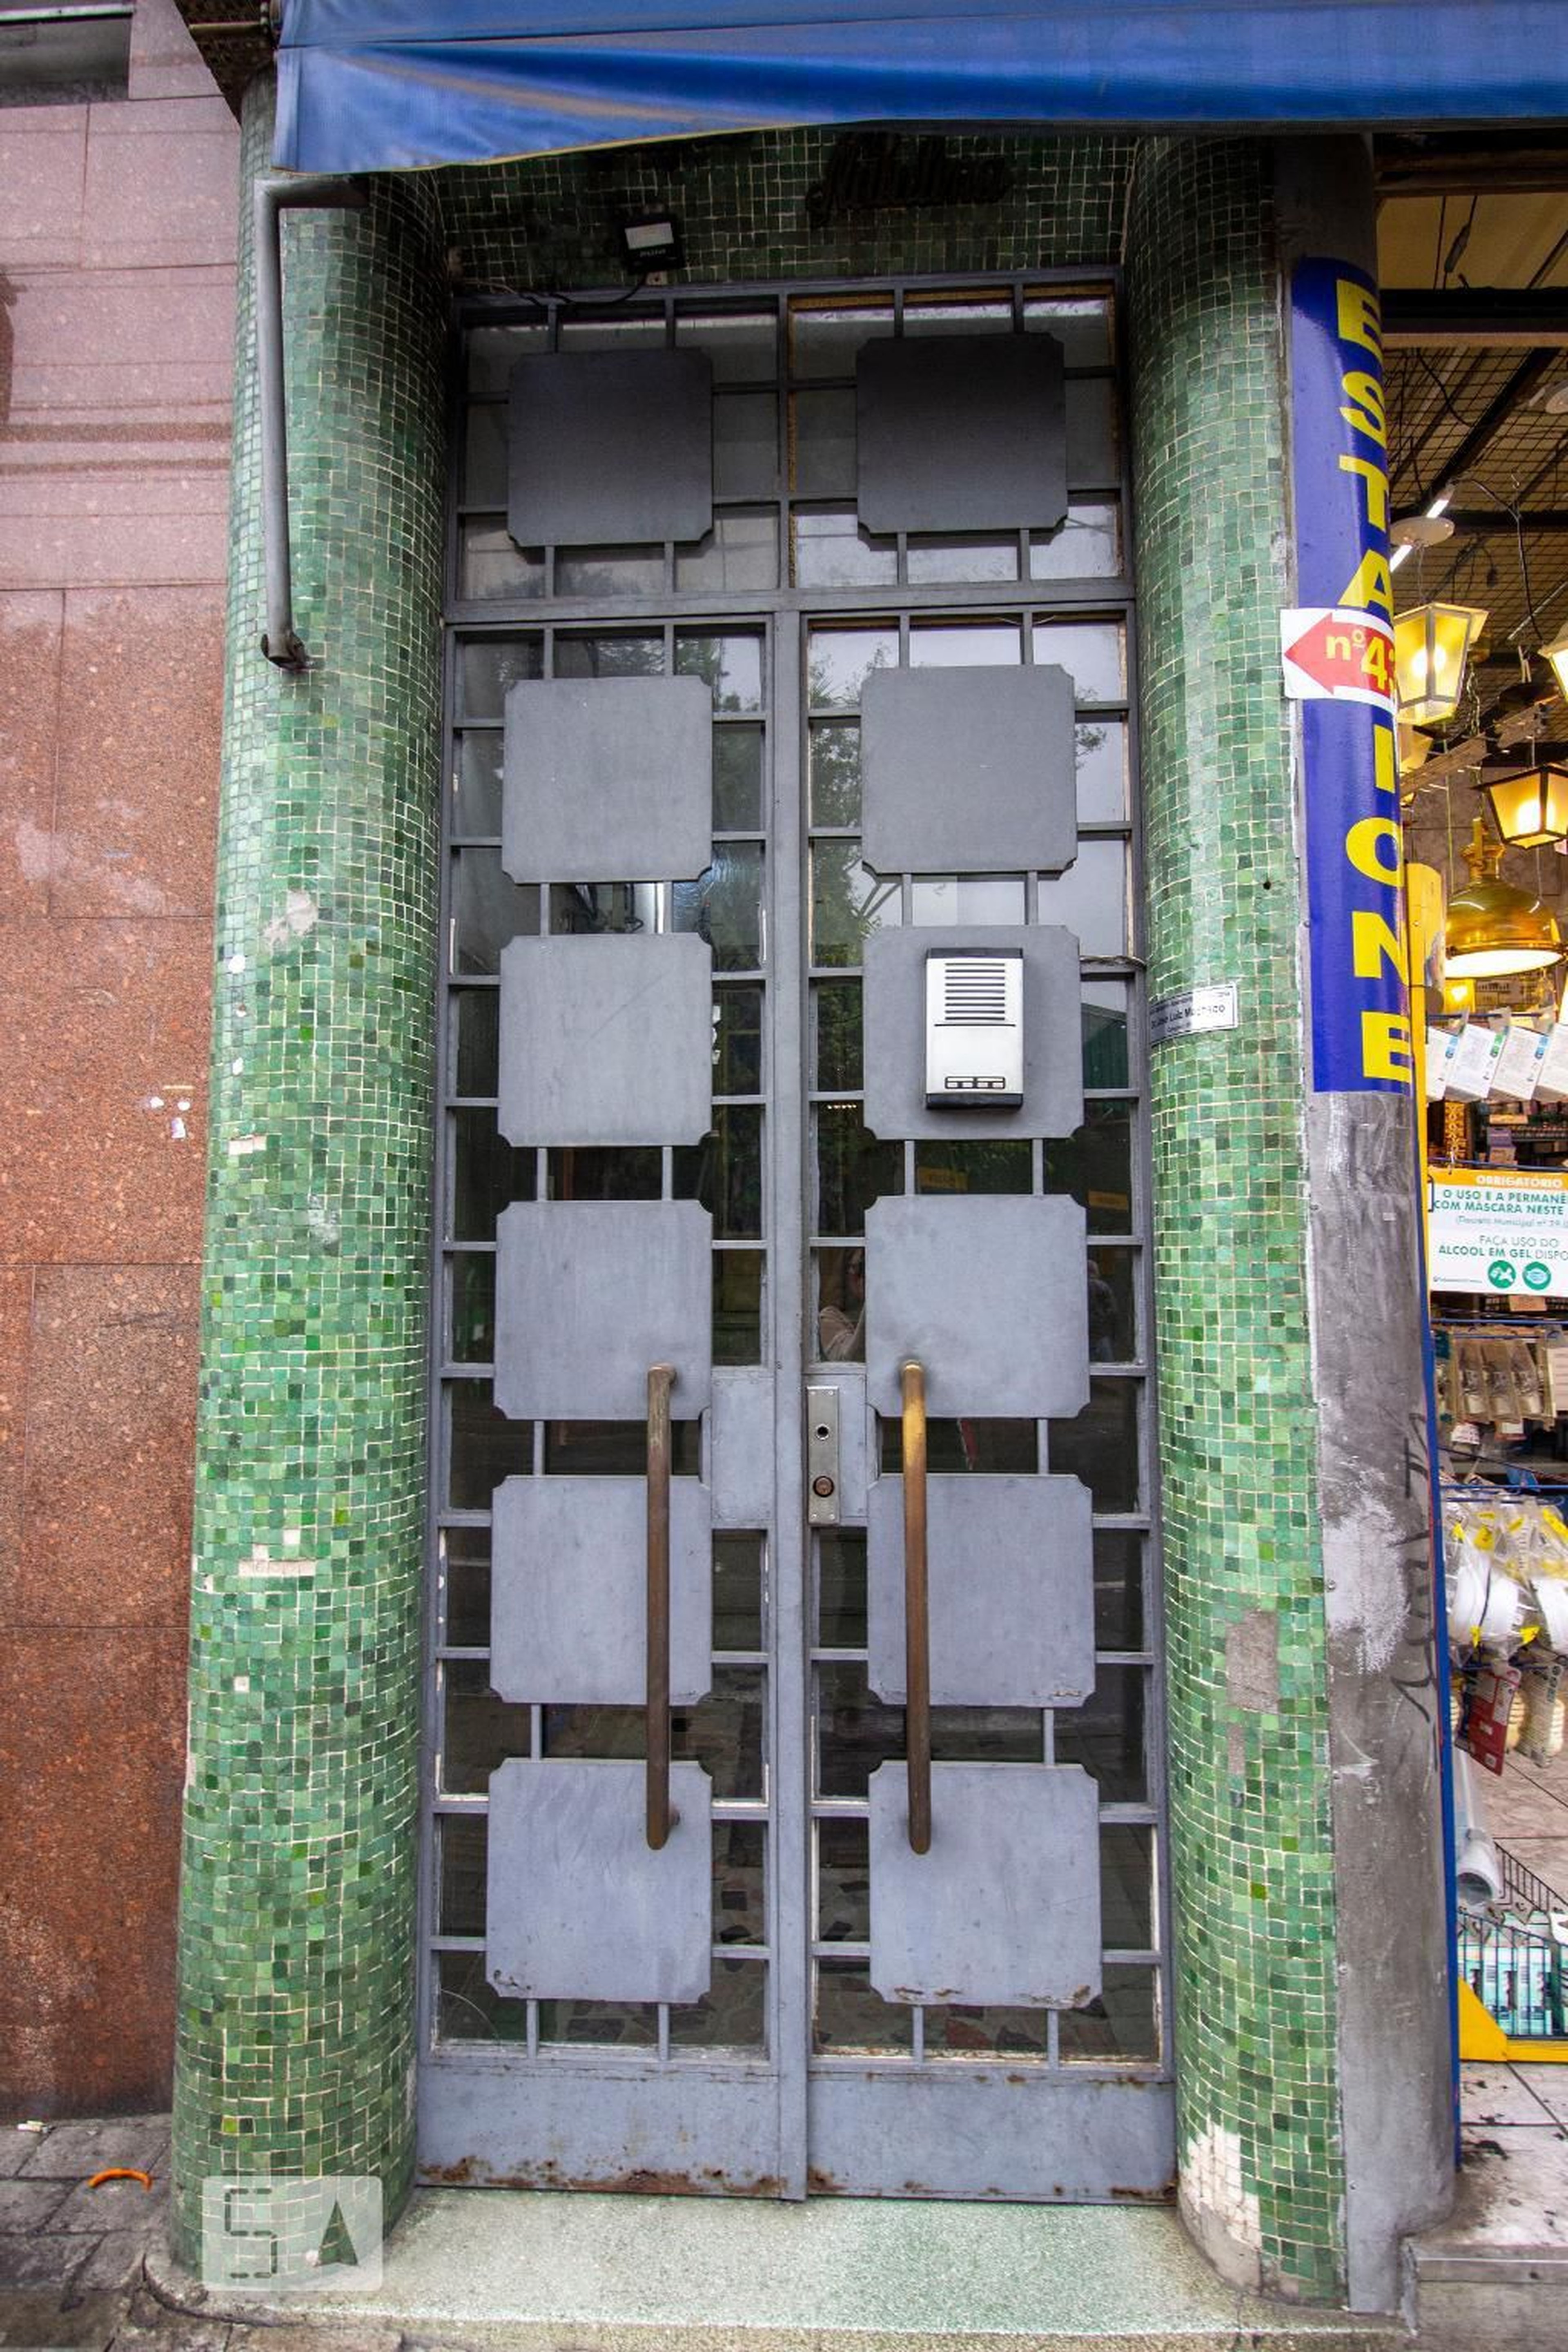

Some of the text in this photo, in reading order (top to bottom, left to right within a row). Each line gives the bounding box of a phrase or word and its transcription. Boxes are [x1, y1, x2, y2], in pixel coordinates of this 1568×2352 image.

[1336, 279, 1411, 1083] ESTAIONE
[1443, 1189, 1452, 1198] O
[1457, 1190, 1482, 1200] USO
[1495, 1192, 1504, 1201] A
[1434, 1200, 1461, 1210] COM
[1527, 1205, 1564, 1216] NESTE
[1511, 1237, 1537, 1248] USO
[1540, 1238, 1559, 1248] DO
[1488, 1248, 1505, 1258] EM
[1509, 1249, 1532, 1258] GEL
